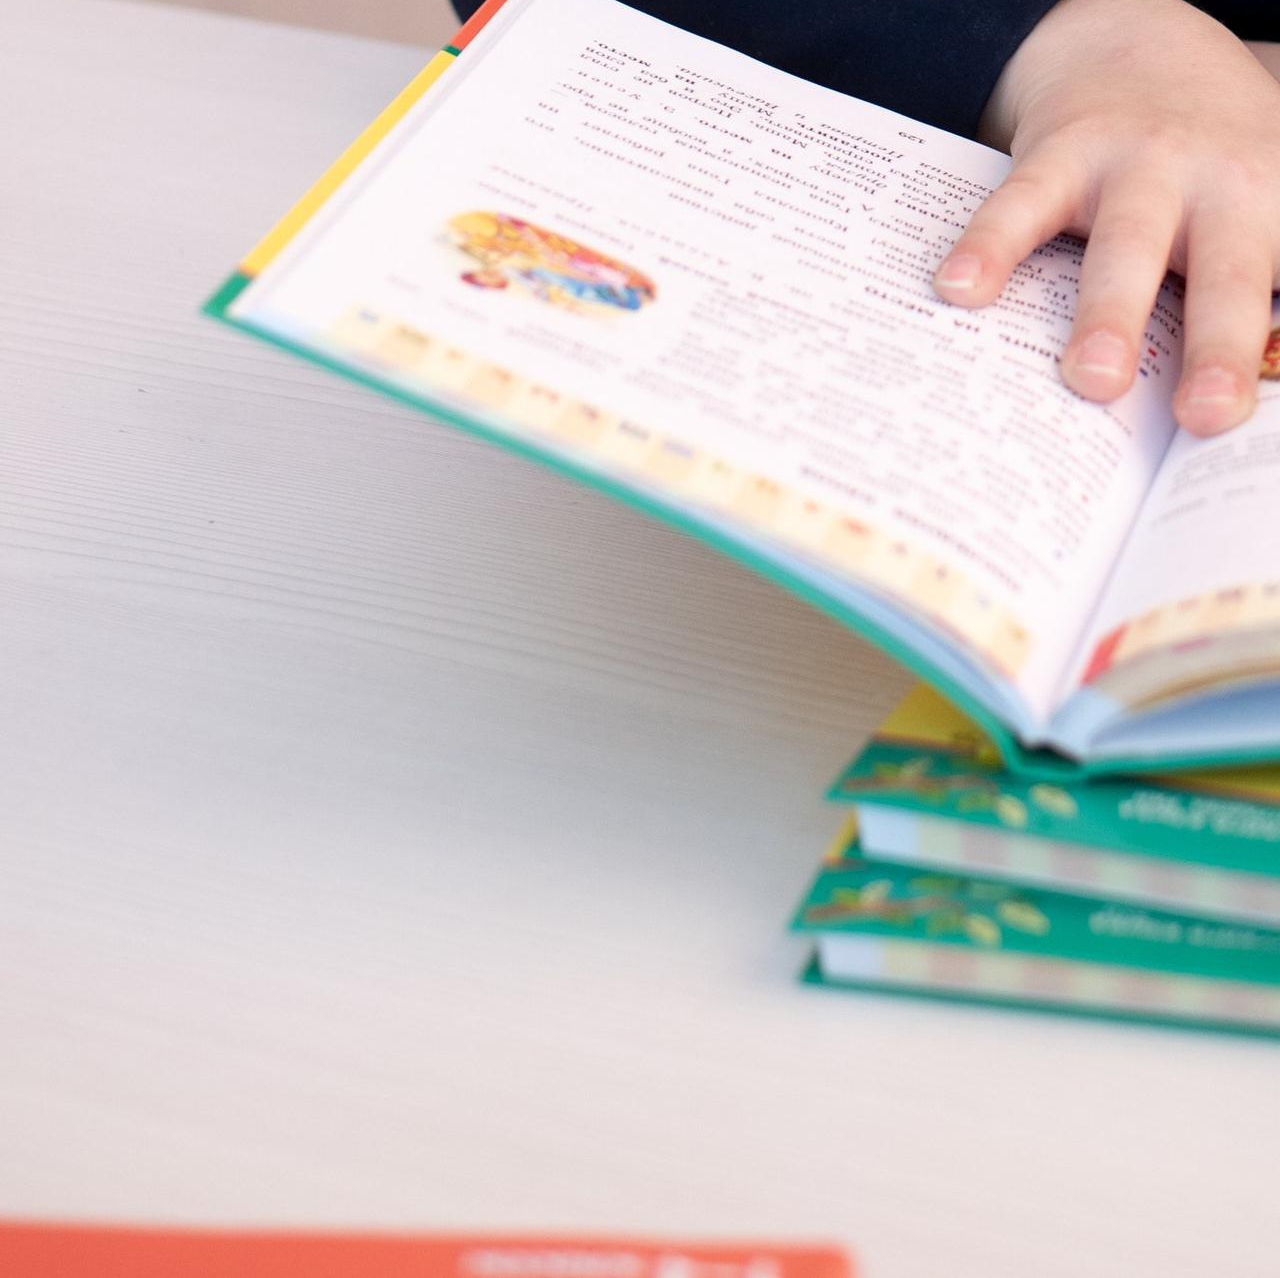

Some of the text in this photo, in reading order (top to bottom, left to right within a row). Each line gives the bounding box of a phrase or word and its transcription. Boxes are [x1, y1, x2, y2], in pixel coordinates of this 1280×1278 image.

[580, 52, 619, 72] стал
[585, 46, 625, 65] слов
[594, 39, 651, 67] место.
[557, 82, 594, 99] кро-
[676, 65, 778, 109] Васечкина.
[579, 98, 657, 134] голосом.
[668, 89, 732, 118] Петров
[709, 96, 742, 113] Это
[717, 92, 773, 117] Машу
[581, 121, 664, 157] работает
[642, 116, 707, 145] вообще
[694, 116, 752, 143] место.
[760, 115, 873, 164] спрашивать.
[797, 122, 891, 162] поставить
[820, 123, 904, 158] Петрова
[674, 138, 791, 188] незнакомым
[687, 162, 730, 185] Гена
[823, 150, 886, 179] понять
[823, 159, 887, 188] друзья.
[889, 167, 928, 187] стал
[748, 157, 845, 200] во-вторых,
[809, 164, 875, 195] Валеру
[902, 182, 947, 204] была
[753, 190, 848, 232] Крокодил
[808, 192, 850, 213] Гена
[868, 216, 942, 249] ответил
